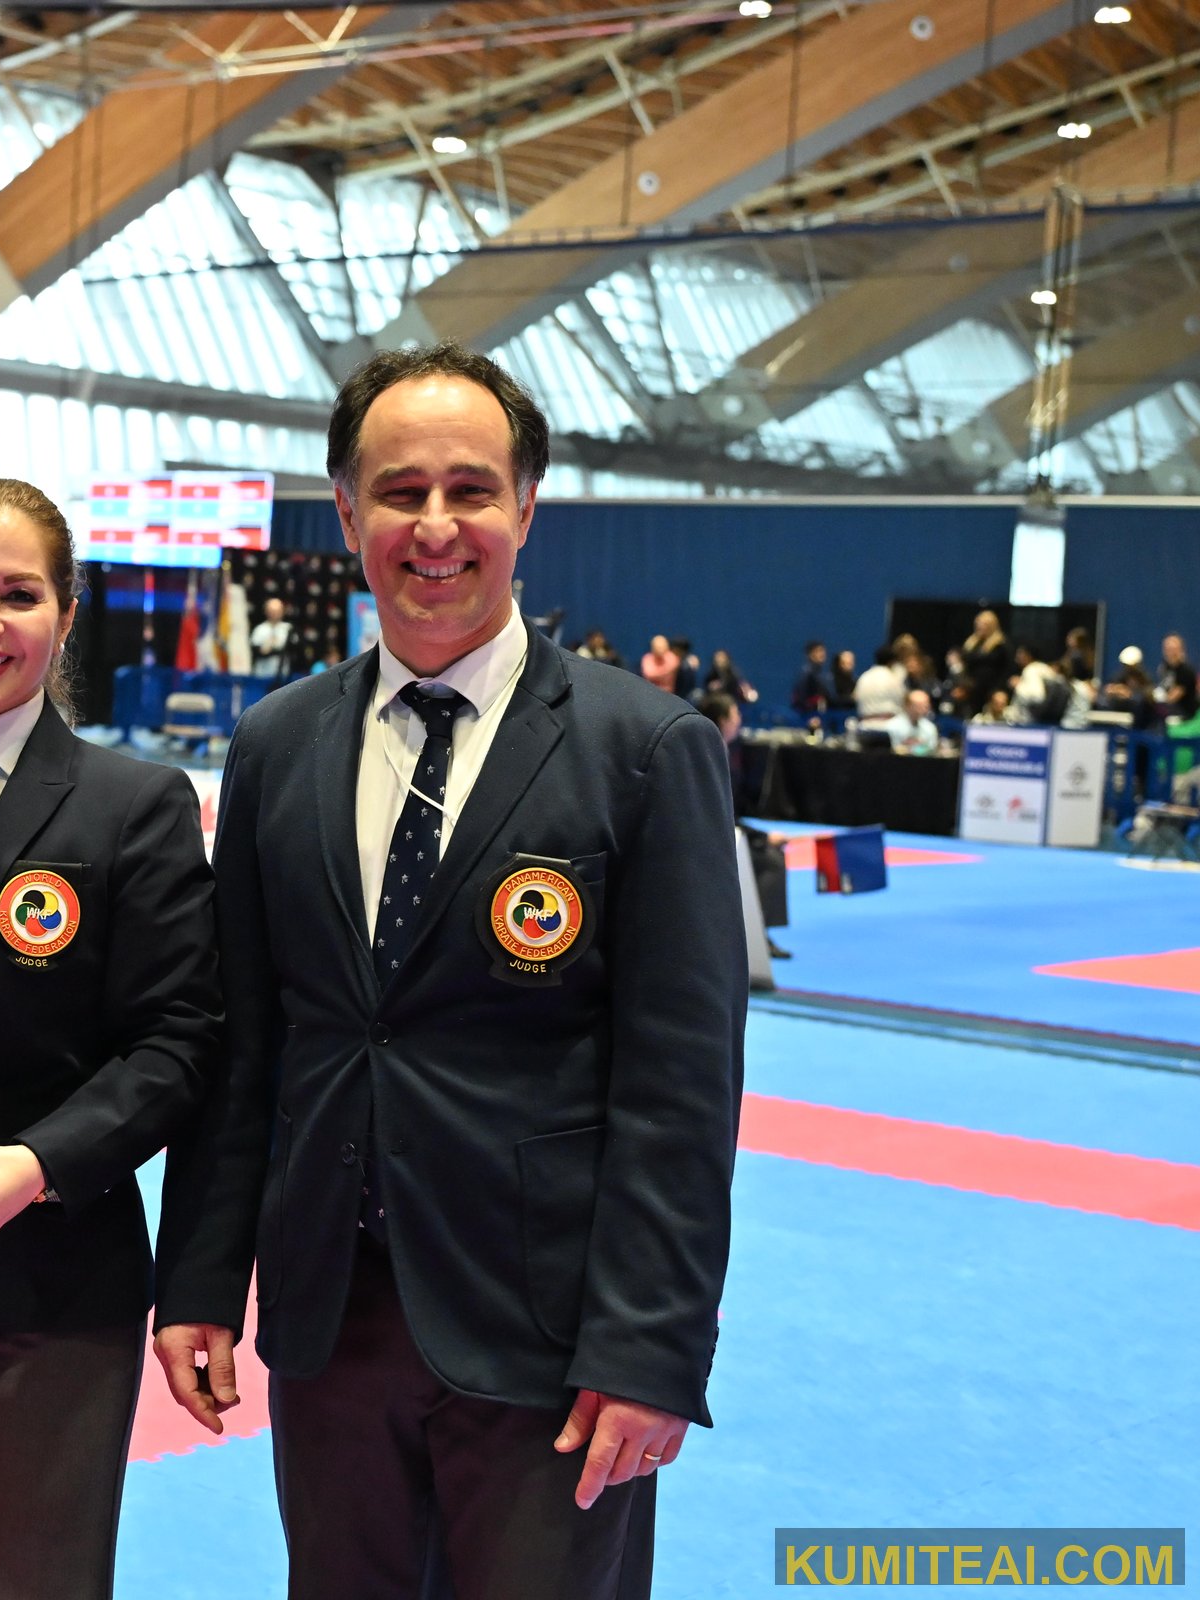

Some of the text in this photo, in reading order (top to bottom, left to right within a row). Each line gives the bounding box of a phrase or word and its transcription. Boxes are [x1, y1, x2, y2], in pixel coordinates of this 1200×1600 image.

[23, 873, 62, 888] WORLD
[504, 871, 575, 902] PANAMERICAN
[523, 906, 553, 921] WKF
[0, 910, 77, 954] KARATE FEDERATION
[494, 915, 577, 958] KARATE FEDERATION
[15, 956, 48, 967] JUDGE
[509, 959, 546, 973] JUDGE
